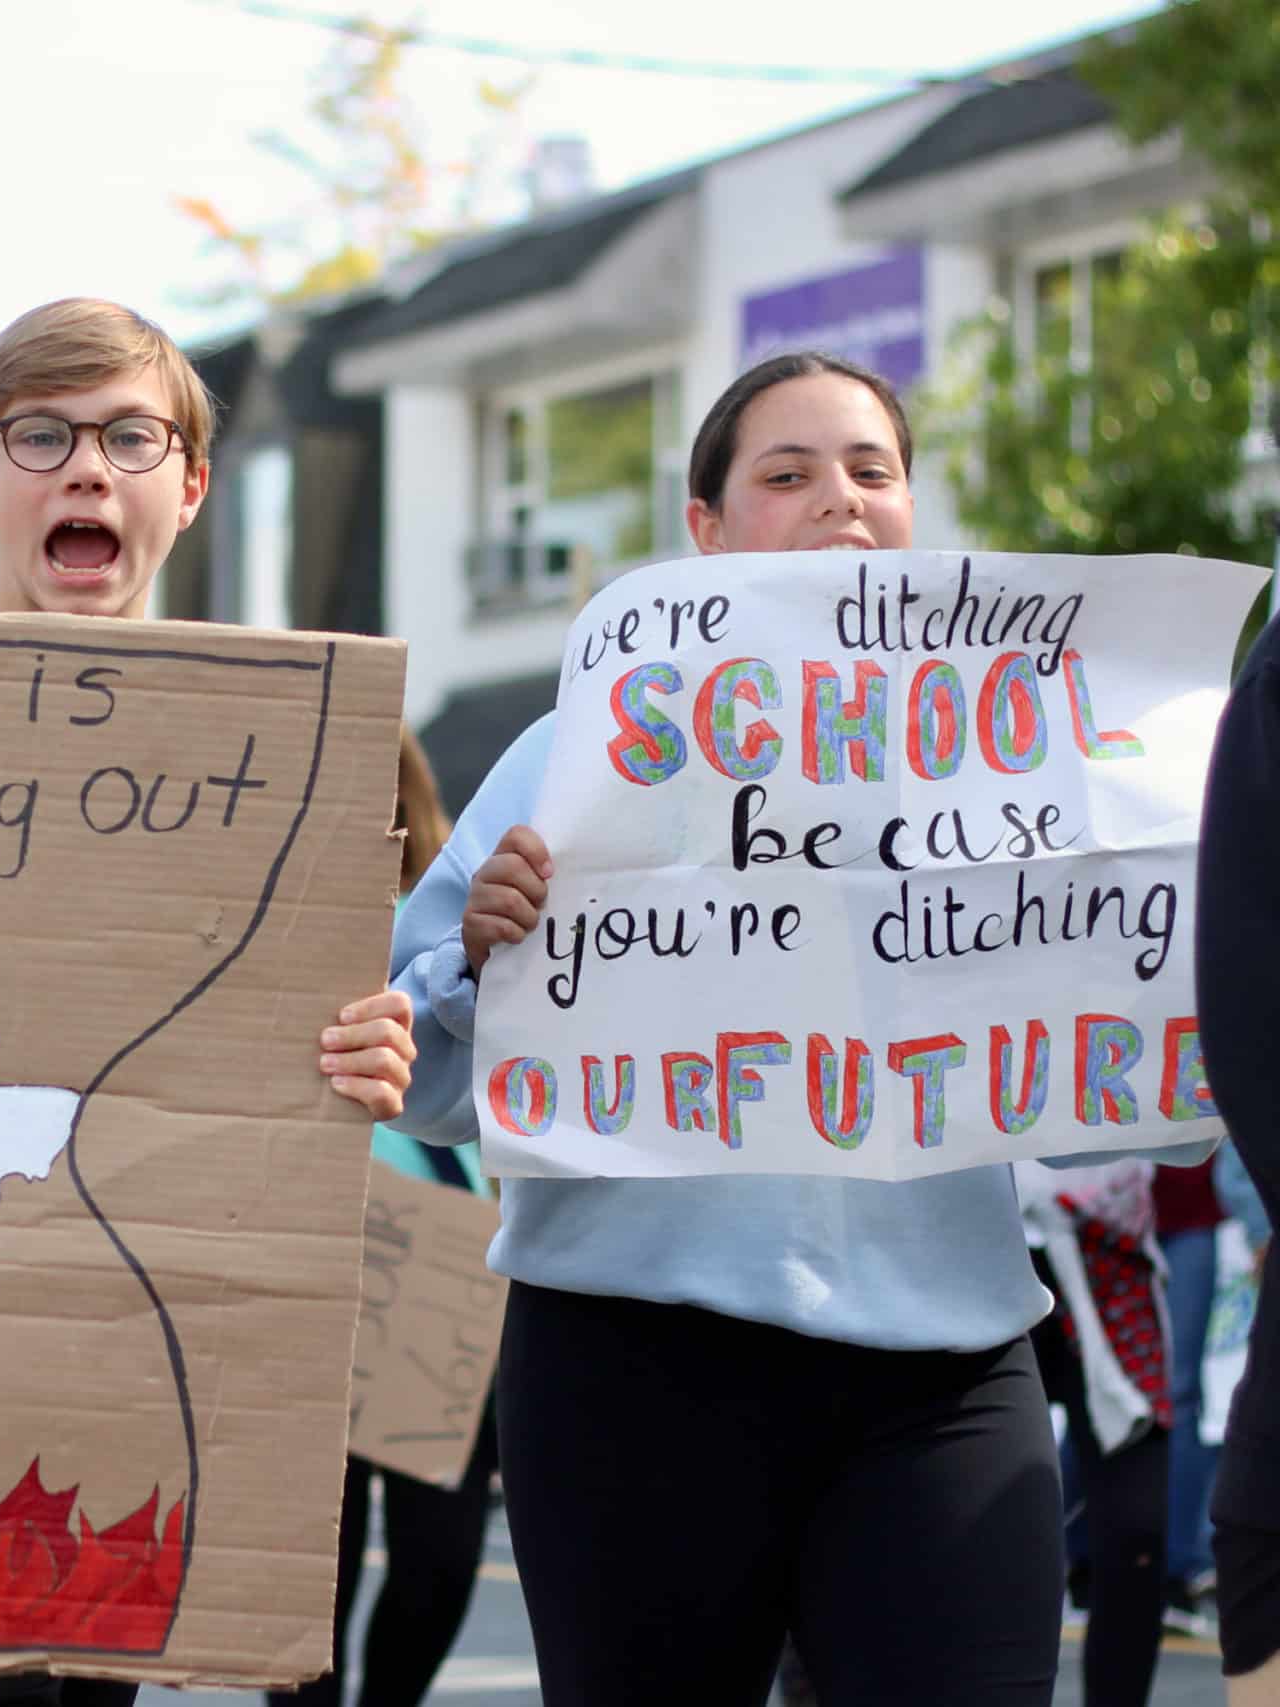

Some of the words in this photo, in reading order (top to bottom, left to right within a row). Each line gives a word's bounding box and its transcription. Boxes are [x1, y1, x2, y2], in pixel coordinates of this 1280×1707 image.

[564, 594, 731, 684] we're
[835, 557, 1084, 677] ditching
[28, 654, 122, 727] is
[607, 649, 1146, 788] SCHOOL
[80, 734, 267, 834] Out
[545, 897, 810, 1010] you're
[872, 870, 1179, 981] ditching
